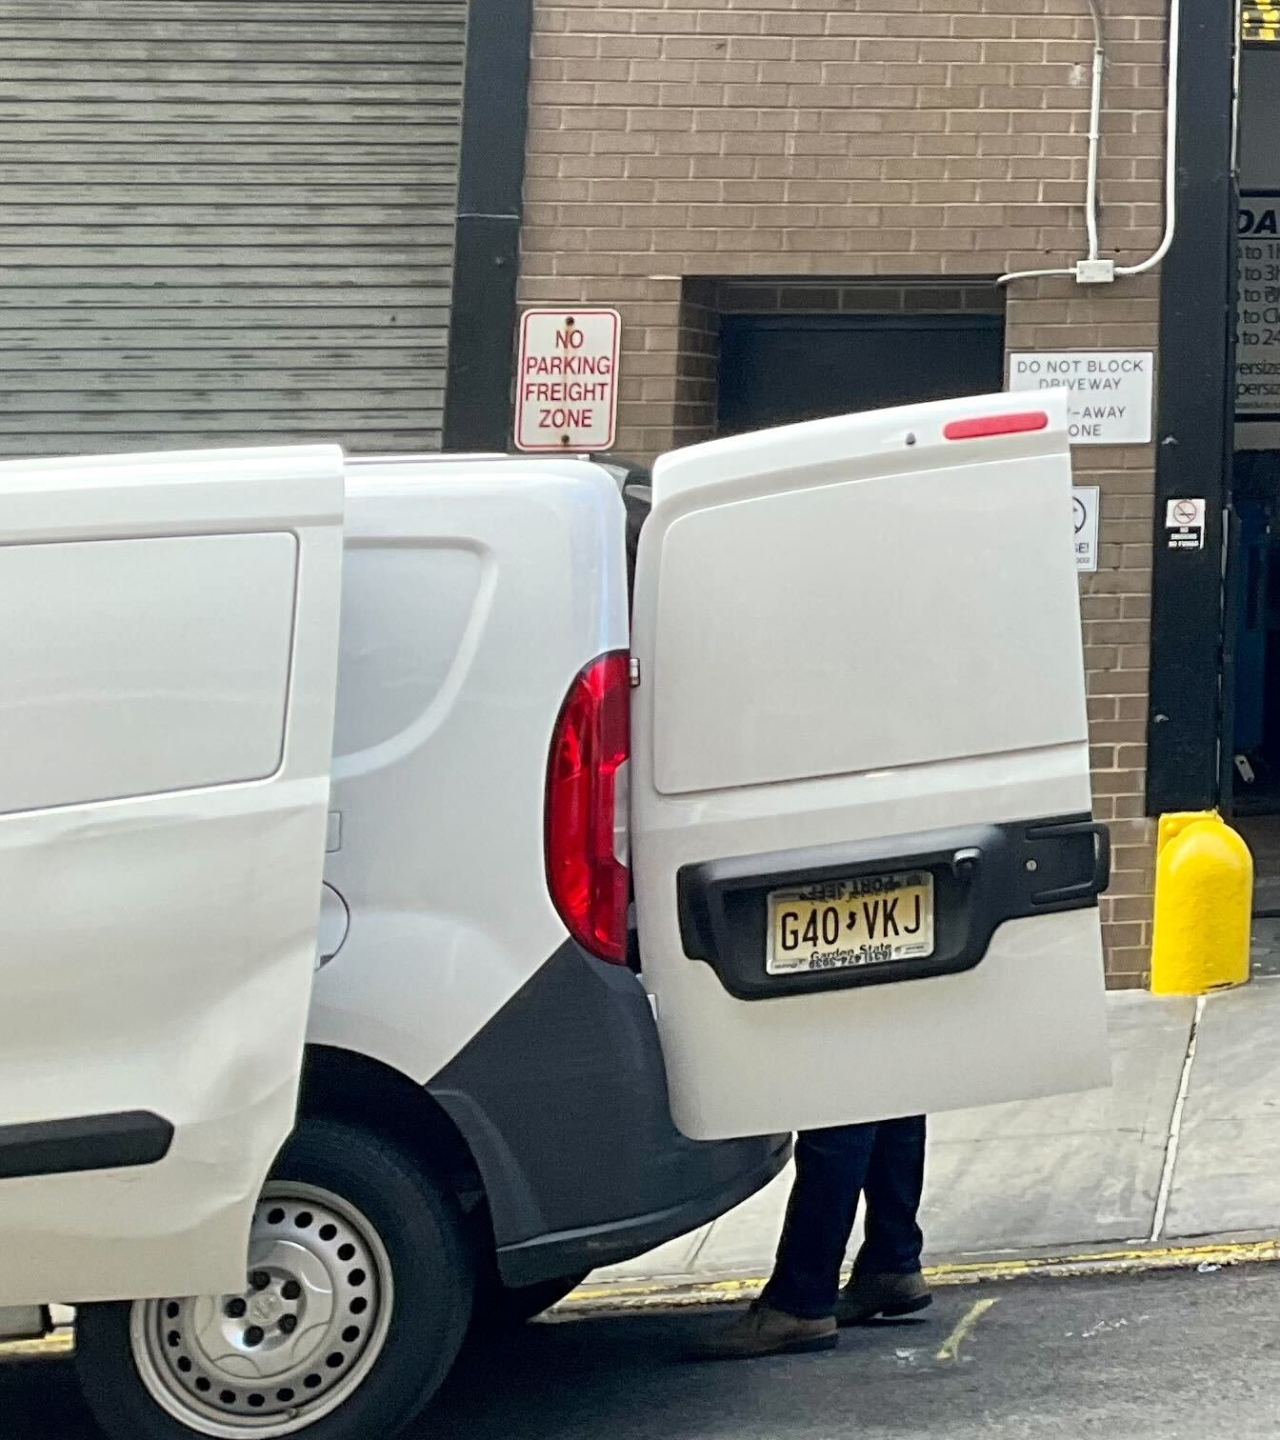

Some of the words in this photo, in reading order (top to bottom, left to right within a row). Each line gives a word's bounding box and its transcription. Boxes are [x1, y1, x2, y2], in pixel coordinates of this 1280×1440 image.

[1245, 246, 1262, 260] to
[1244, 267, 1262, 282] to
[1244, 289, 1261, 302] to
[1243, 310, 1260, 324] to
[556, 329, 584, 349] NO
[1242, 331, 1260, 346] to
[526, 356, 611, 375] PARKING
[1017, 360, 1042, 374] DO
[1047, 360, 1082, 373] NOT
[1087, 359, 1144, 373] BLOCK
[525, 382, 609, 401] FREIGHT
[1038, 377, 1123, 391] DRIVEWAY
[538, 409, 593, 428] ZONE
[1068, 423, 1102, 437] ONE
[781, 906, 839, 951] G40
[863, 894, 921, 939] VKJ
[810, 947, 854, 960] Garden
[859, 943, 892, 954] State
